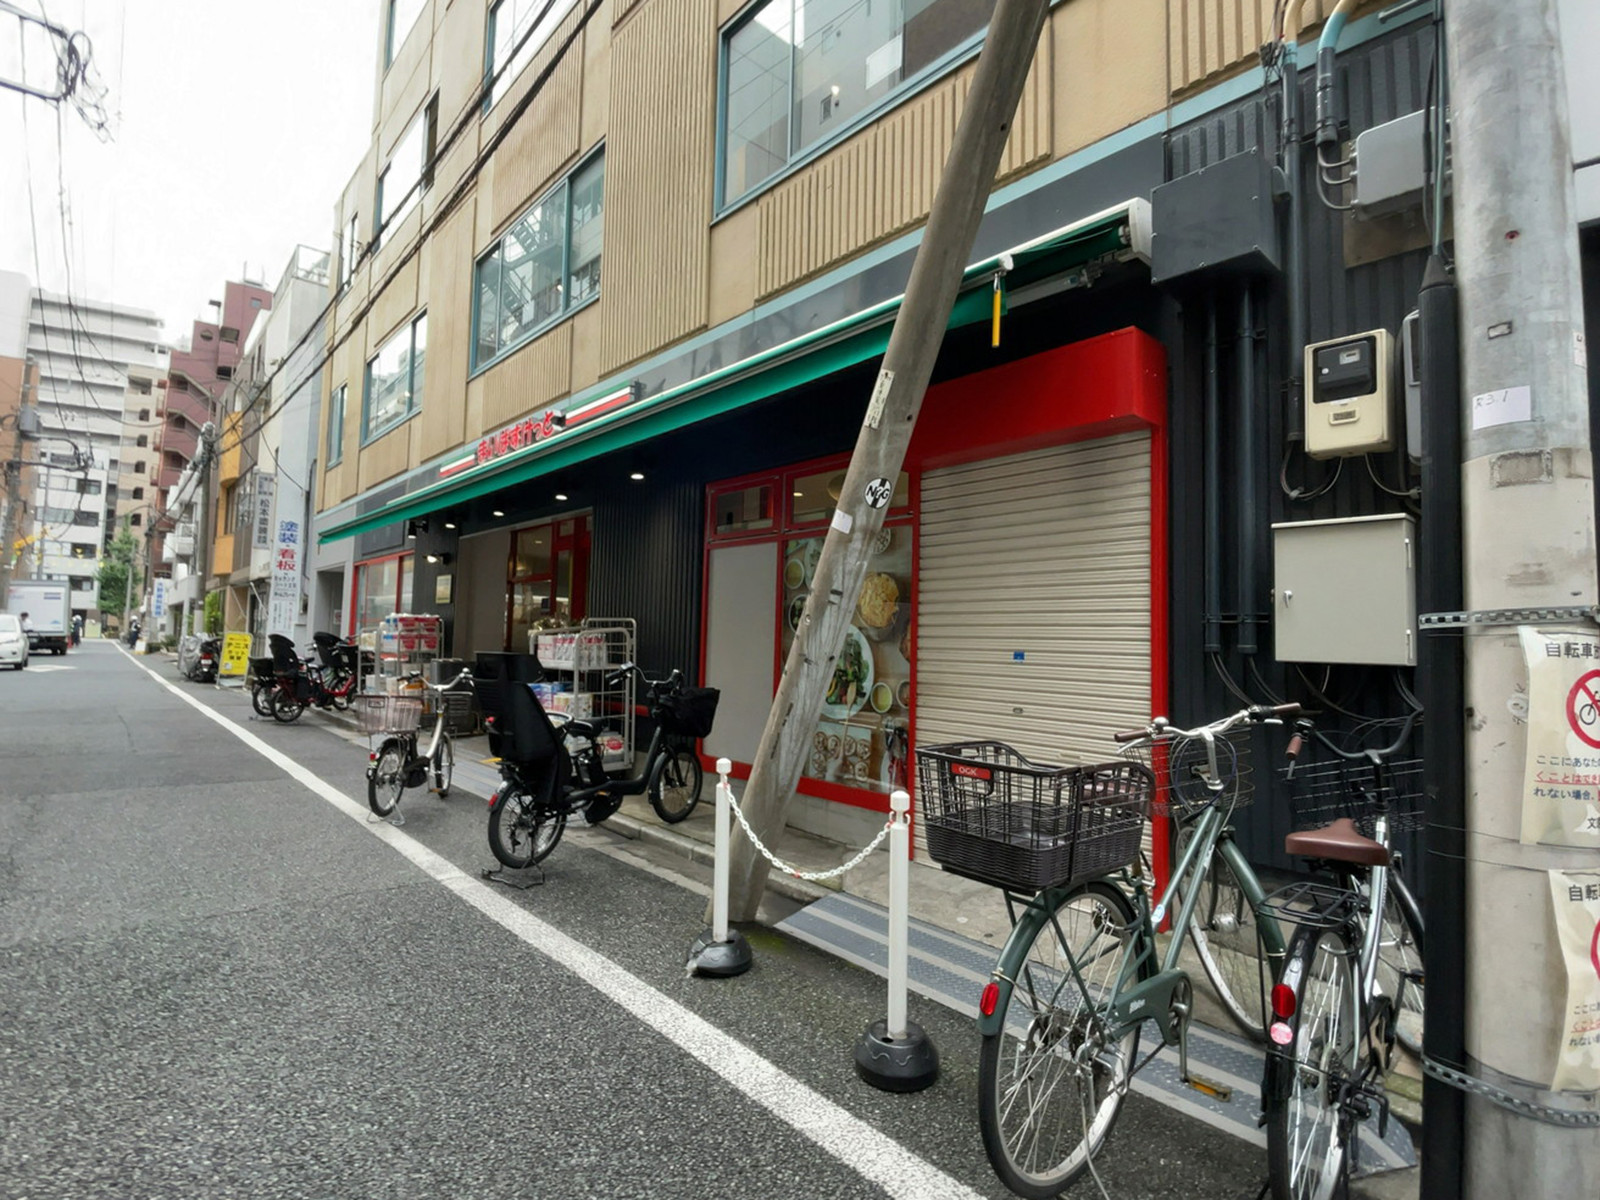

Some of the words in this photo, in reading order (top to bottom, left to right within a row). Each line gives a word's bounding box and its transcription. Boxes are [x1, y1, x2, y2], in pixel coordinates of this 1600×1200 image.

[478, 411, 555, 464] まいばすけっと
[1536, 755, 1600, 768] ここにあなた
[1536, 770, 1600, 784] くことはでき
[1568, 884, 1600, 901] 自転
